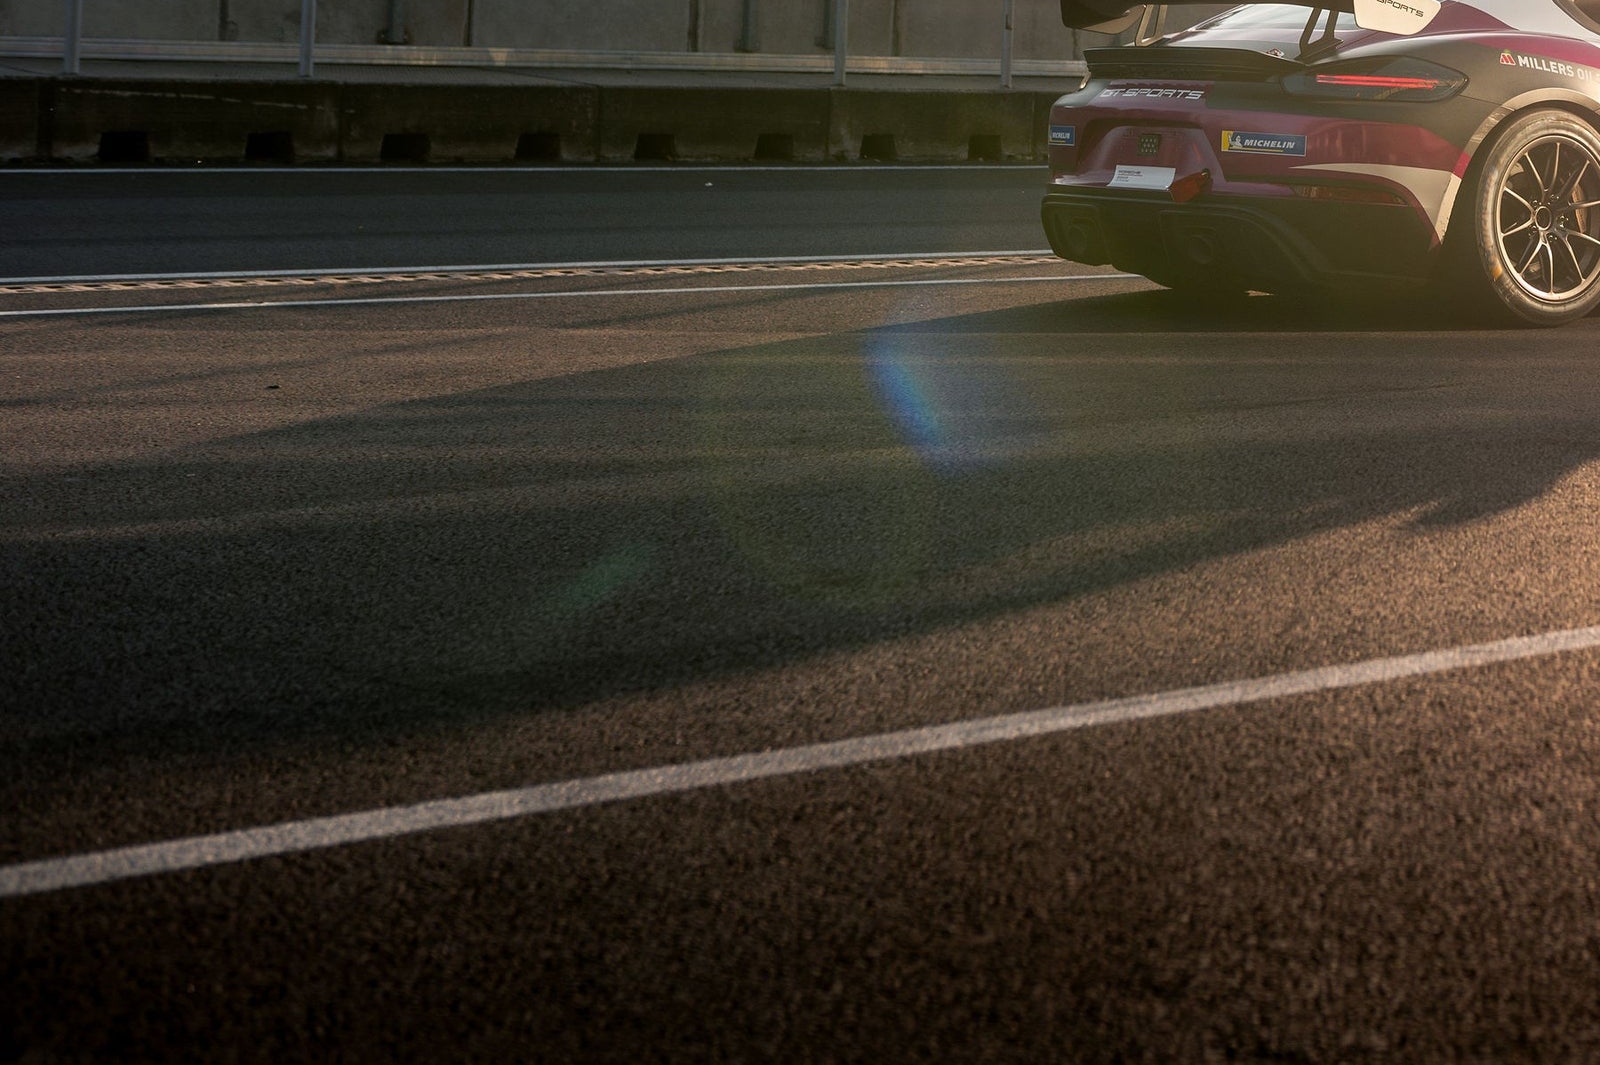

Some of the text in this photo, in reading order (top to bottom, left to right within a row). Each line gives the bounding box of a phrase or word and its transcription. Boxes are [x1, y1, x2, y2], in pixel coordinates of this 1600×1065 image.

[1517, 55, 1574, 77] MILLERS
[1100, 88, 1205, 100] GT SPORTS
[1244, 139, 1296, 149] MICHELIN
